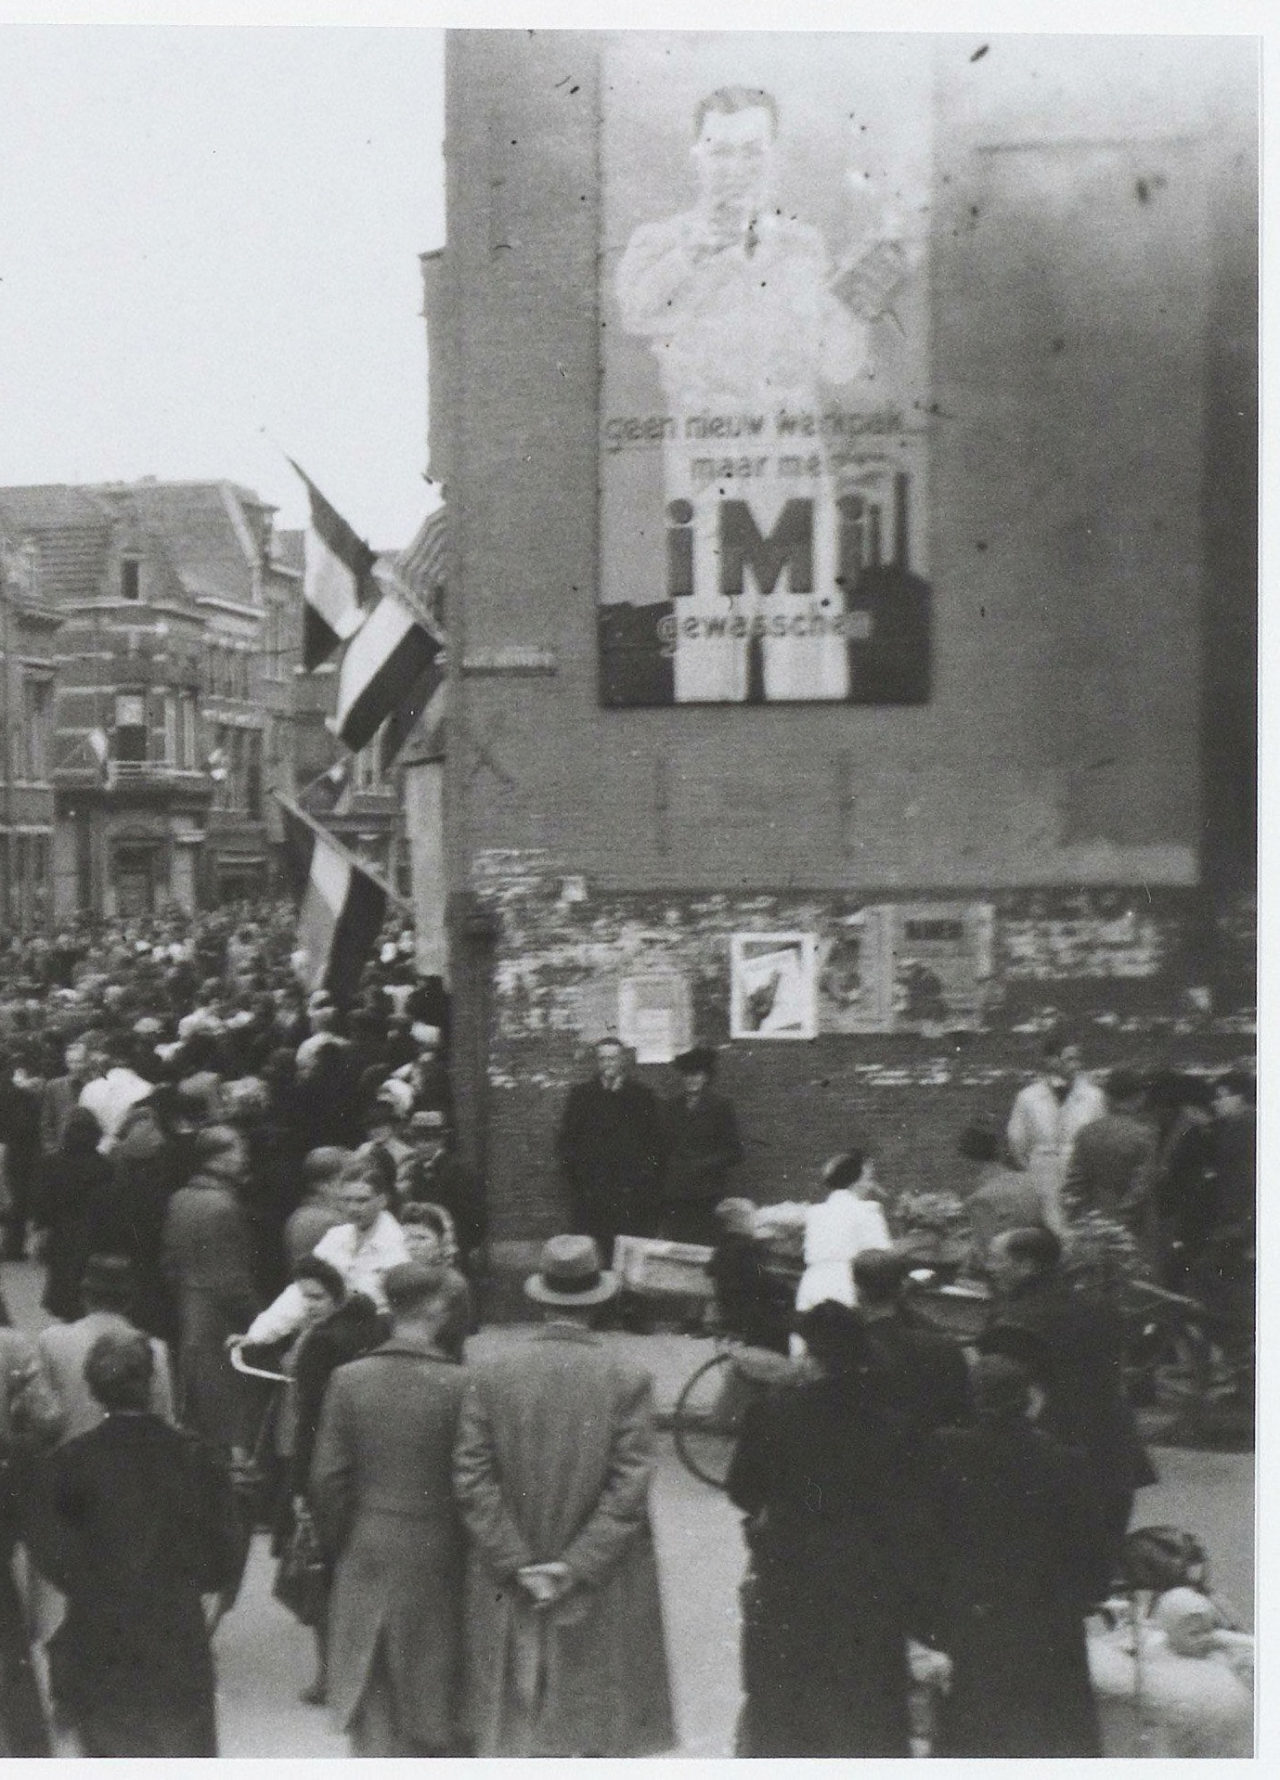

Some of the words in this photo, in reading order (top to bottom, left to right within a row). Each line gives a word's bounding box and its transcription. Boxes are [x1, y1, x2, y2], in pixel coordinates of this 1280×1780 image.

[606, 416, 675, 454] geen
[683, 412, 765, 440] nieuw
[776, 408, 903, 447] werkpak
[690, 455, 769, 480] maar
[656, 606, 872, 658] gewasschen
